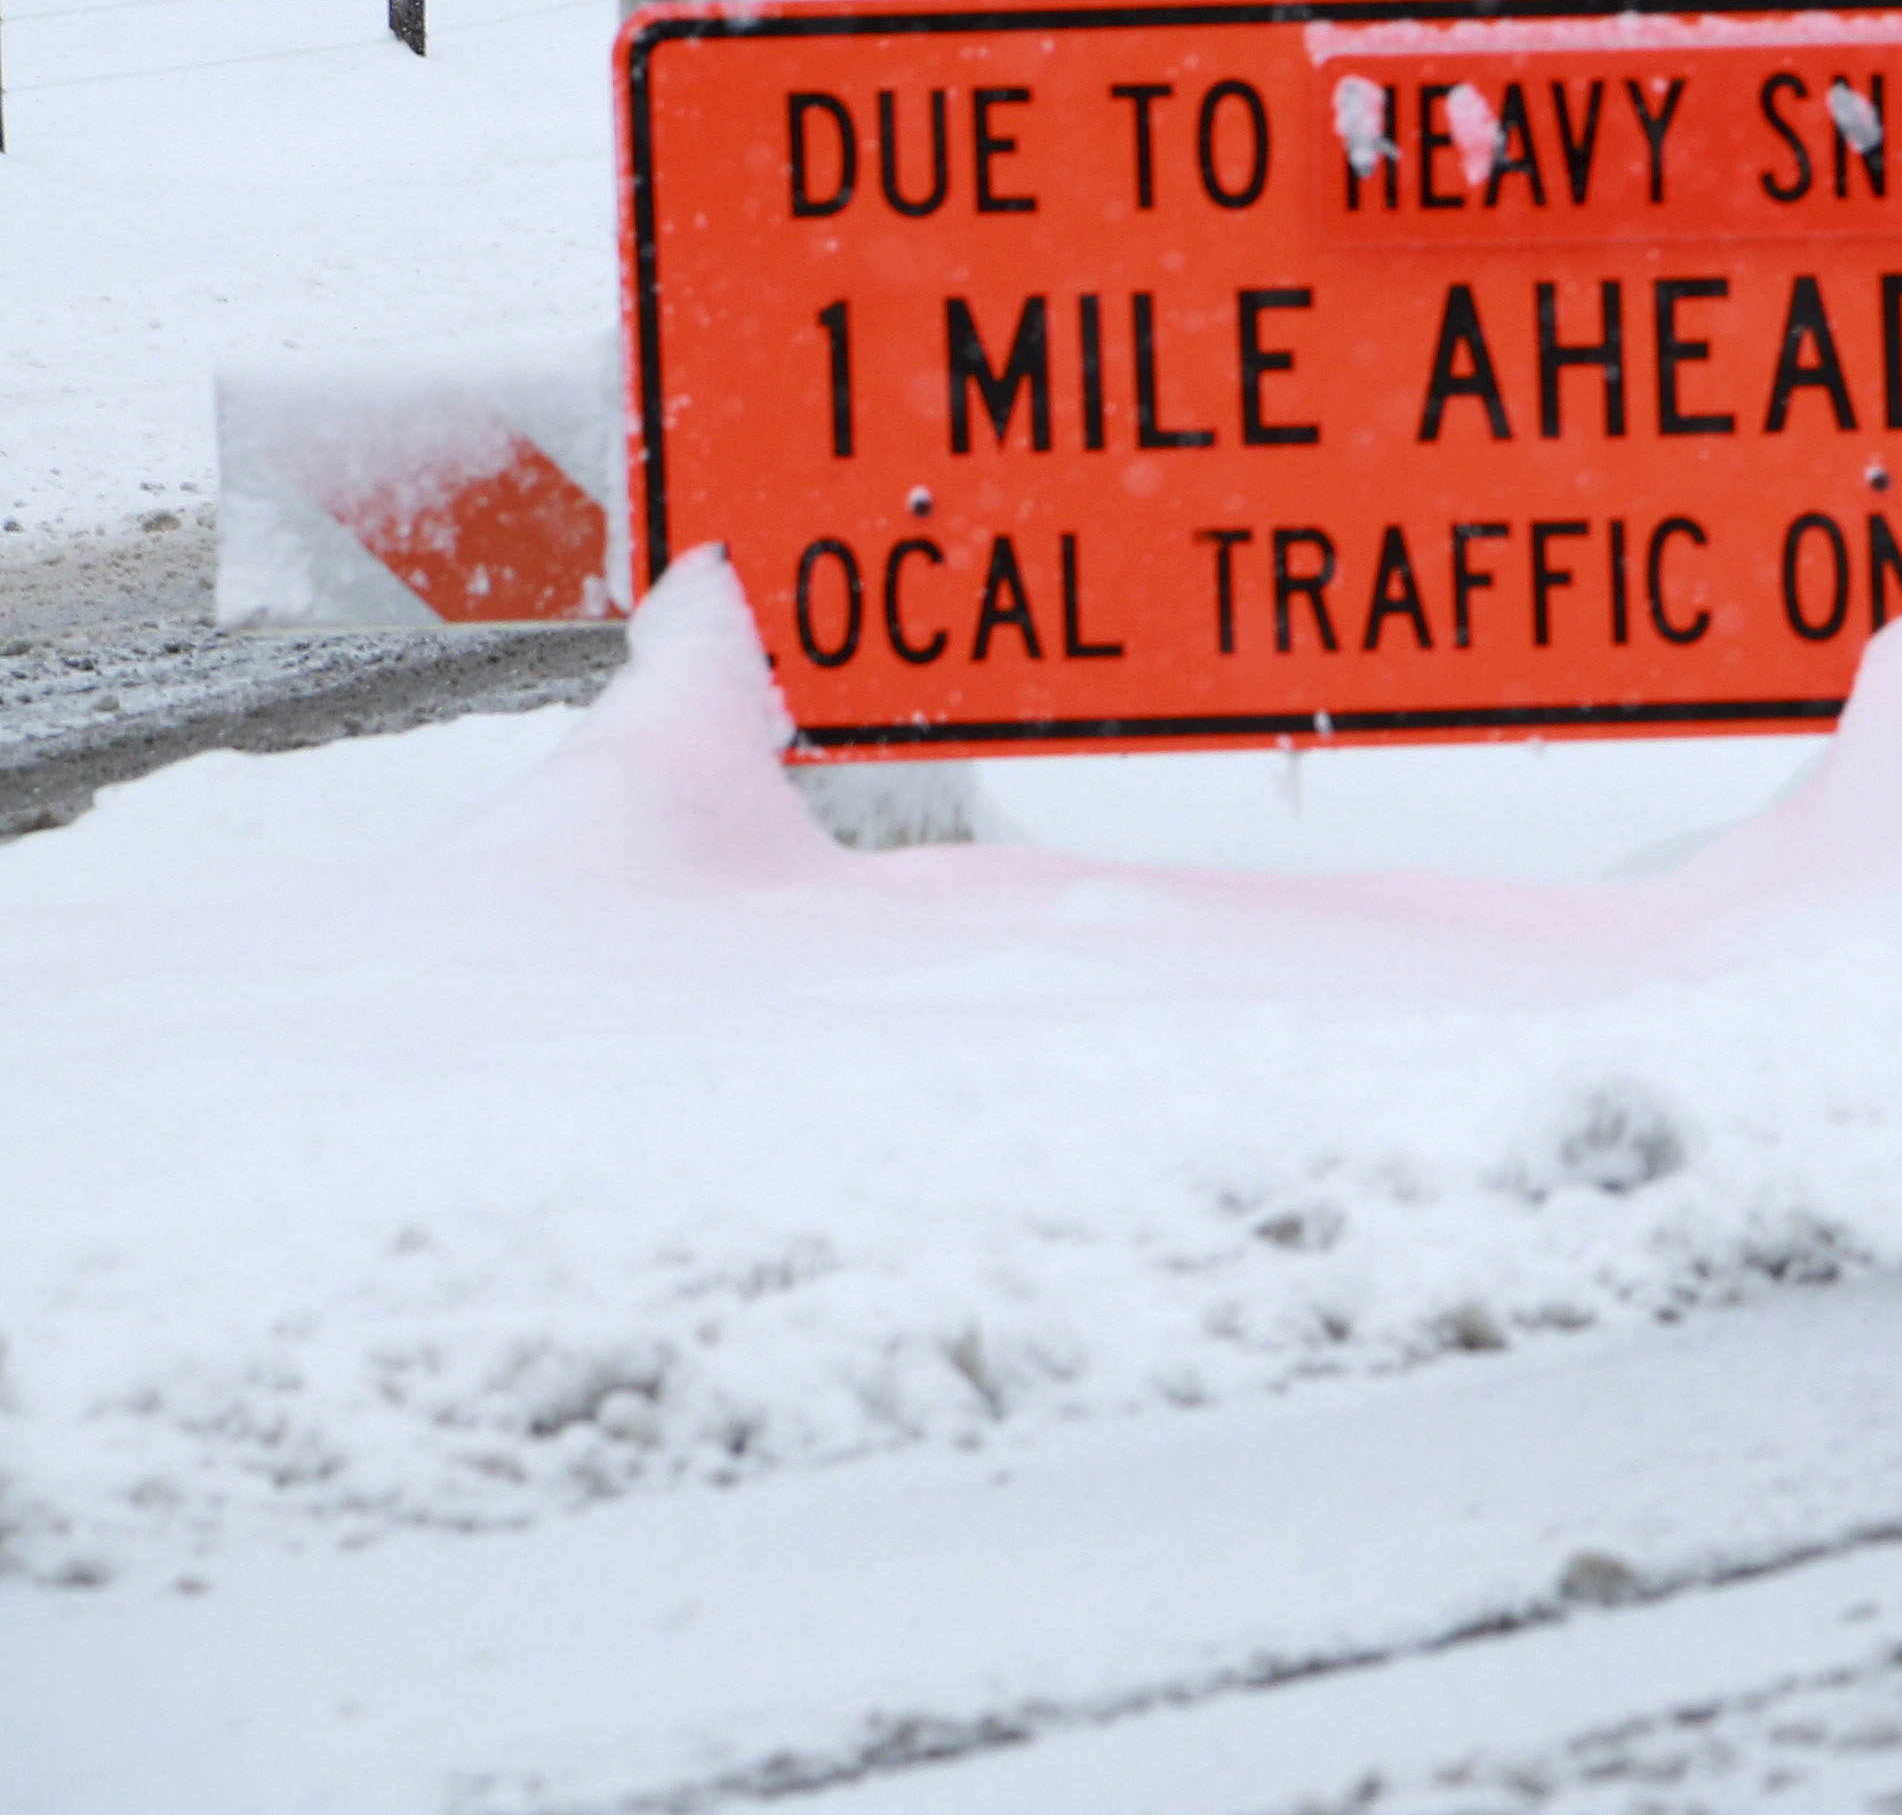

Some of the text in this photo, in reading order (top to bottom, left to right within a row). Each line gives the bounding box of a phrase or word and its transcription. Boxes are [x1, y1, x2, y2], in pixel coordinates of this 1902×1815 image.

[787, 86, 1038, 219] DUE
[1111, 79, 1270, 210] TO
[817, 299, 854, 458] 1
[945, 288, 1321, 455] MILE
[768, 532, 1125, 669] OCAL
[1194, 515, 1711, 655] TRAFFIC
